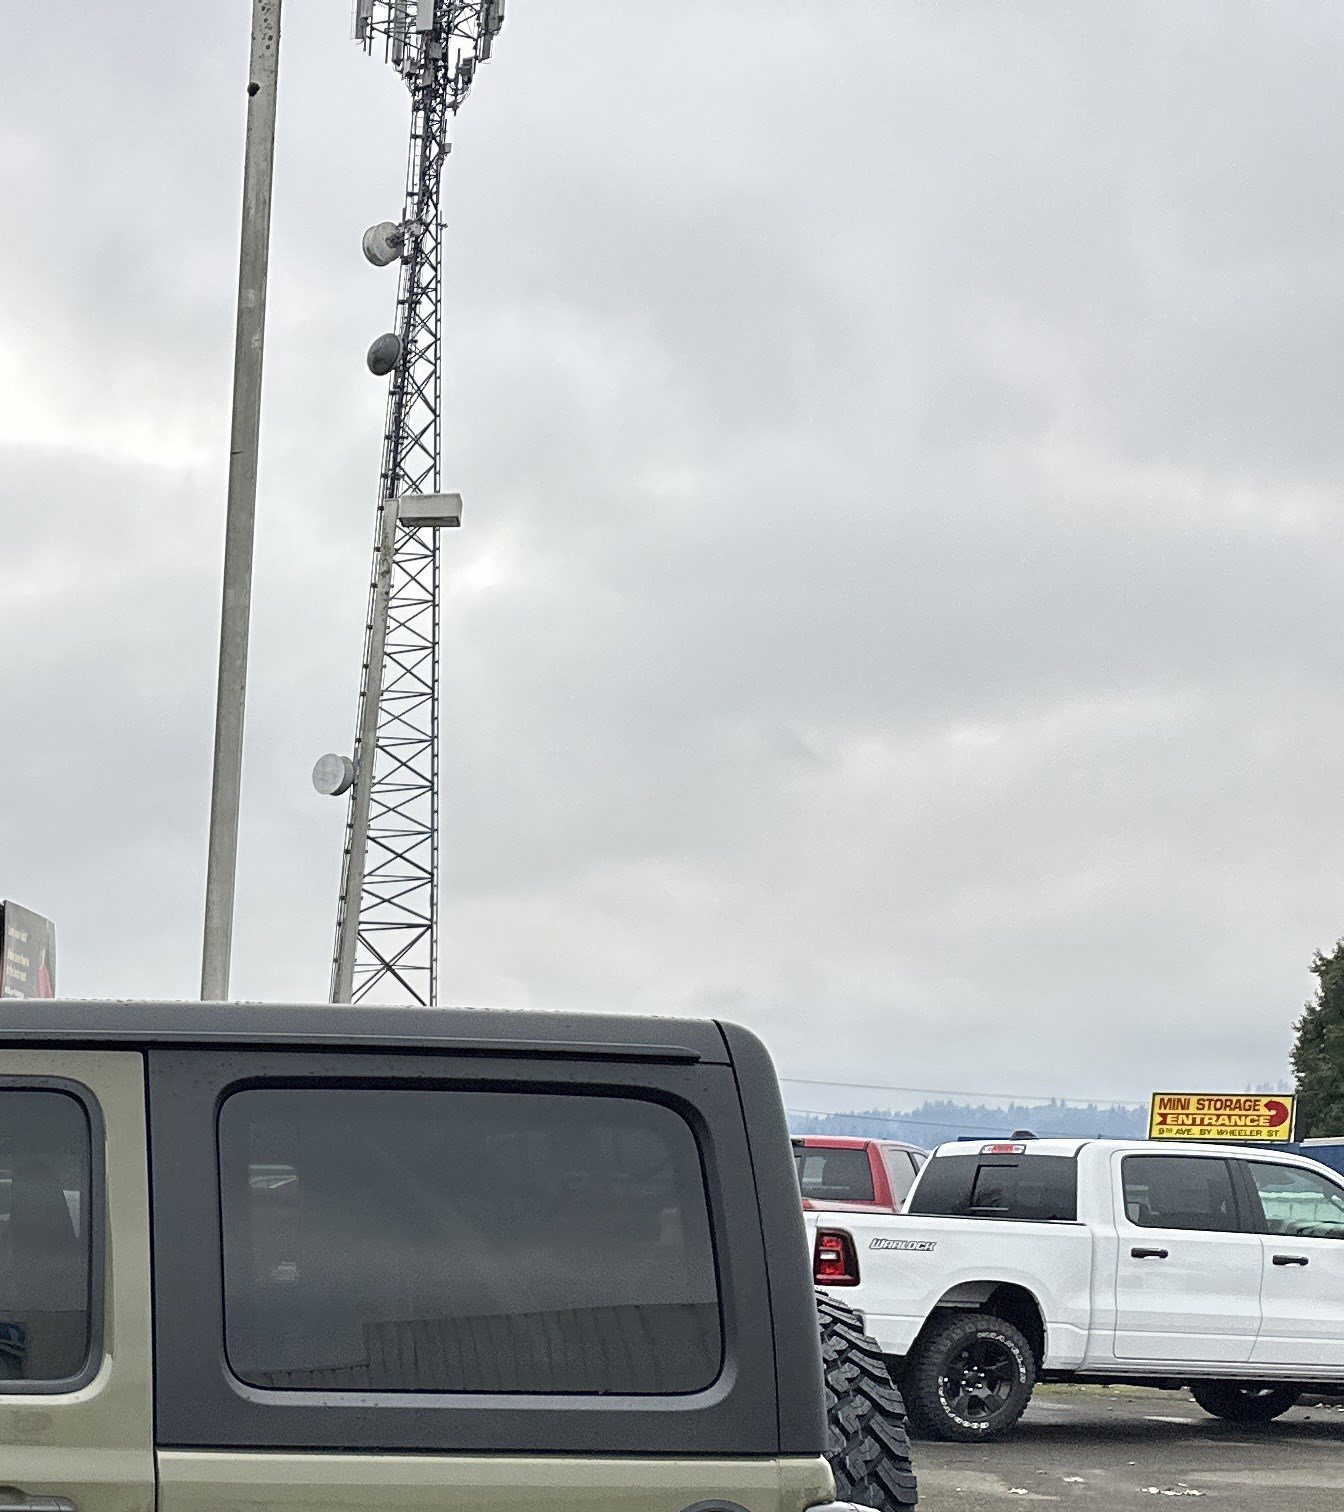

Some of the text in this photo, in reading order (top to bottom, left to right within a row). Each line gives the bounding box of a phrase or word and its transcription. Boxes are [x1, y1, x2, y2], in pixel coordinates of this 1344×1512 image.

[1158, 1097, 1261, 1112] MINI STORAGE
[1166, 1114, 1270, 1126] ENTRANCE
[1216, 1129, 1262, 1137] WHEELER
[869, 1238, 937, 1252] WARLOCK
